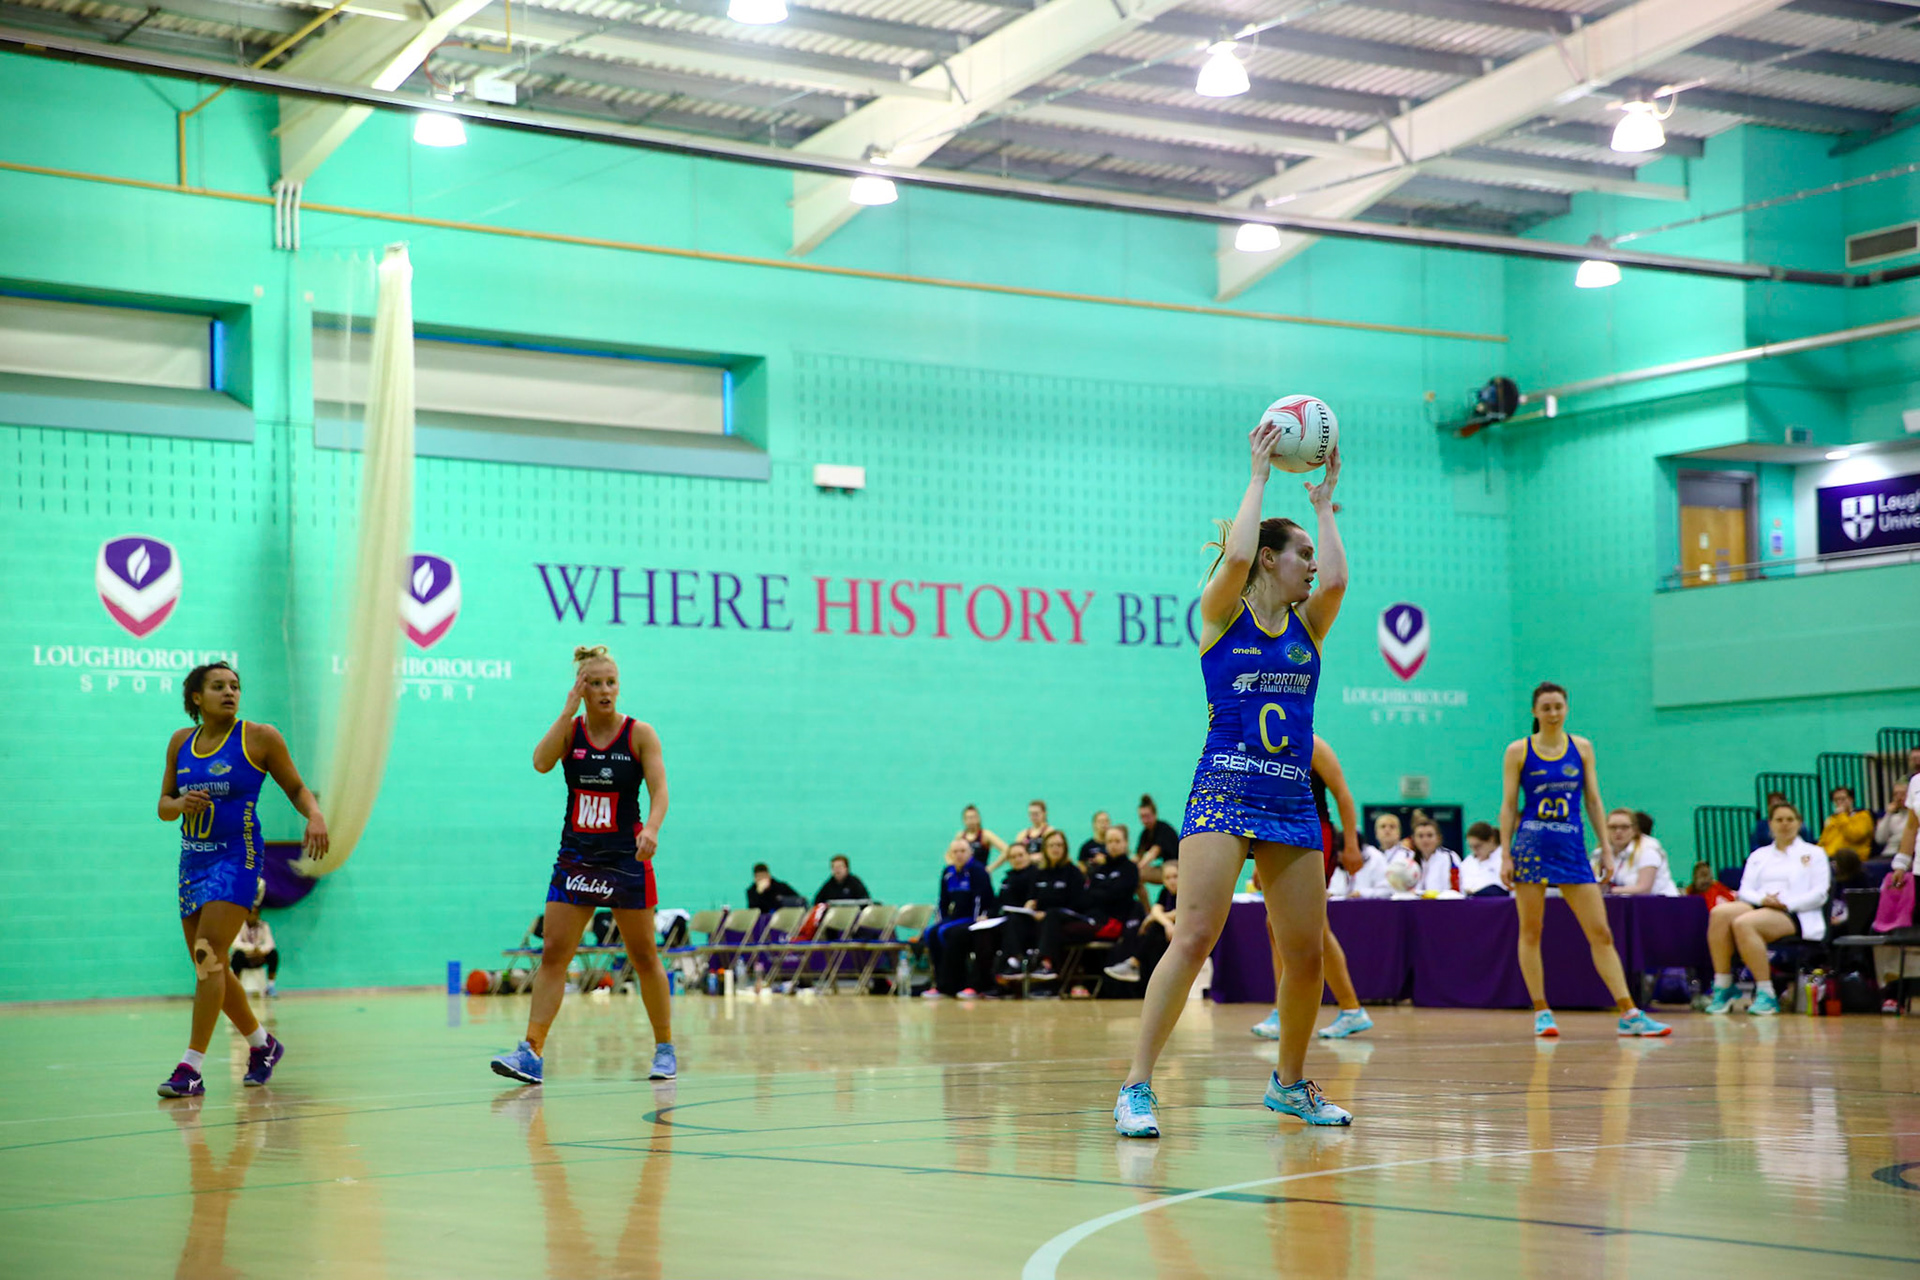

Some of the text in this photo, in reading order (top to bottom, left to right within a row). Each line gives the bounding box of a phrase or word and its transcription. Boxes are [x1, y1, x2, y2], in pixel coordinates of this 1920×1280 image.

[1316, 403, 1330, 461] GILBERT
[534, 562, 794, 632] WHERE
[812, 576, 1096, 644] HISTORY
[1232, 647, 1262, 655] oneills
[80, 674, 173, 692] SPOR
[1260, 673, 1312, 686] SPORTING
[1260, 685, 1307, 695] FAMILY CHANGE
[1259, 702, 1289, 754] C
[1212, 754, 1308, 781] RENGEN
[577, 793, 611, 829] WA
[566, 874, 614, 900] Vitality
